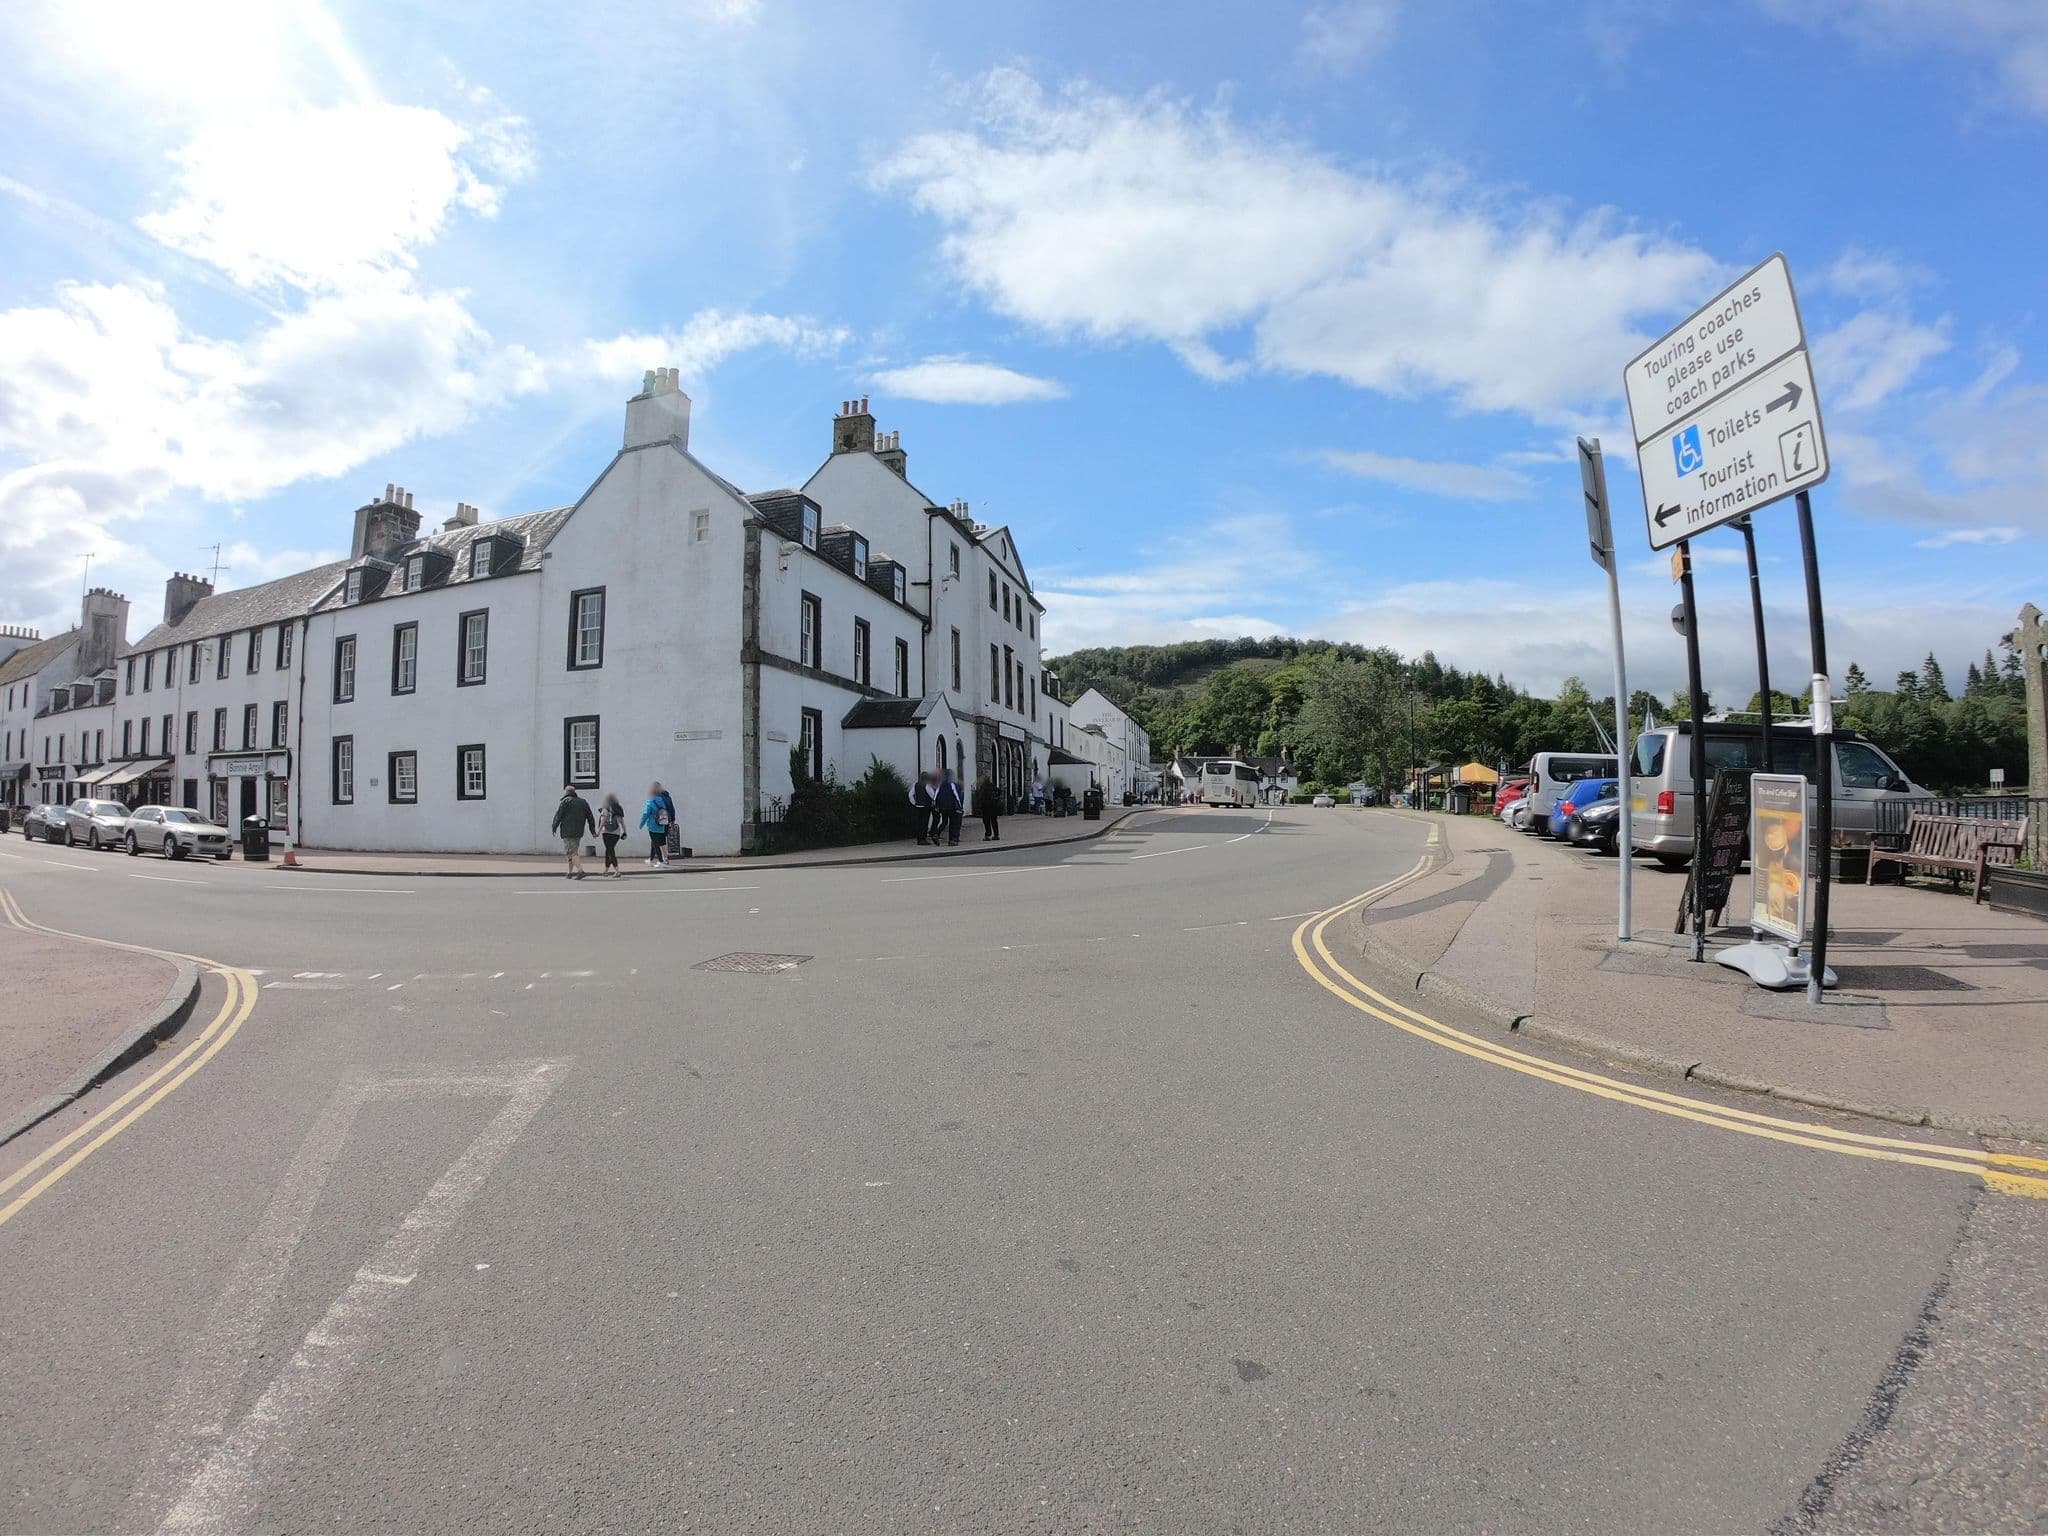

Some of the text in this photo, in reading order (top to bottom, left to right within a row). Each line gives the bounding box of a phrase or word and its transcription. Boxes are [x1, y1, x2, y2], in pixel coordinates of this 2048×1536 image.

[1643, 285, 1761, 380] Touring coaches
[1667, 327, 1744, 392] please use
[1666, 345, 1756, 415] coach parks
[1707, 407, 1761, 448] Toilets
[1686, 472, 1778, 525] information
[1698, 450, 1755, 492] Tourist
